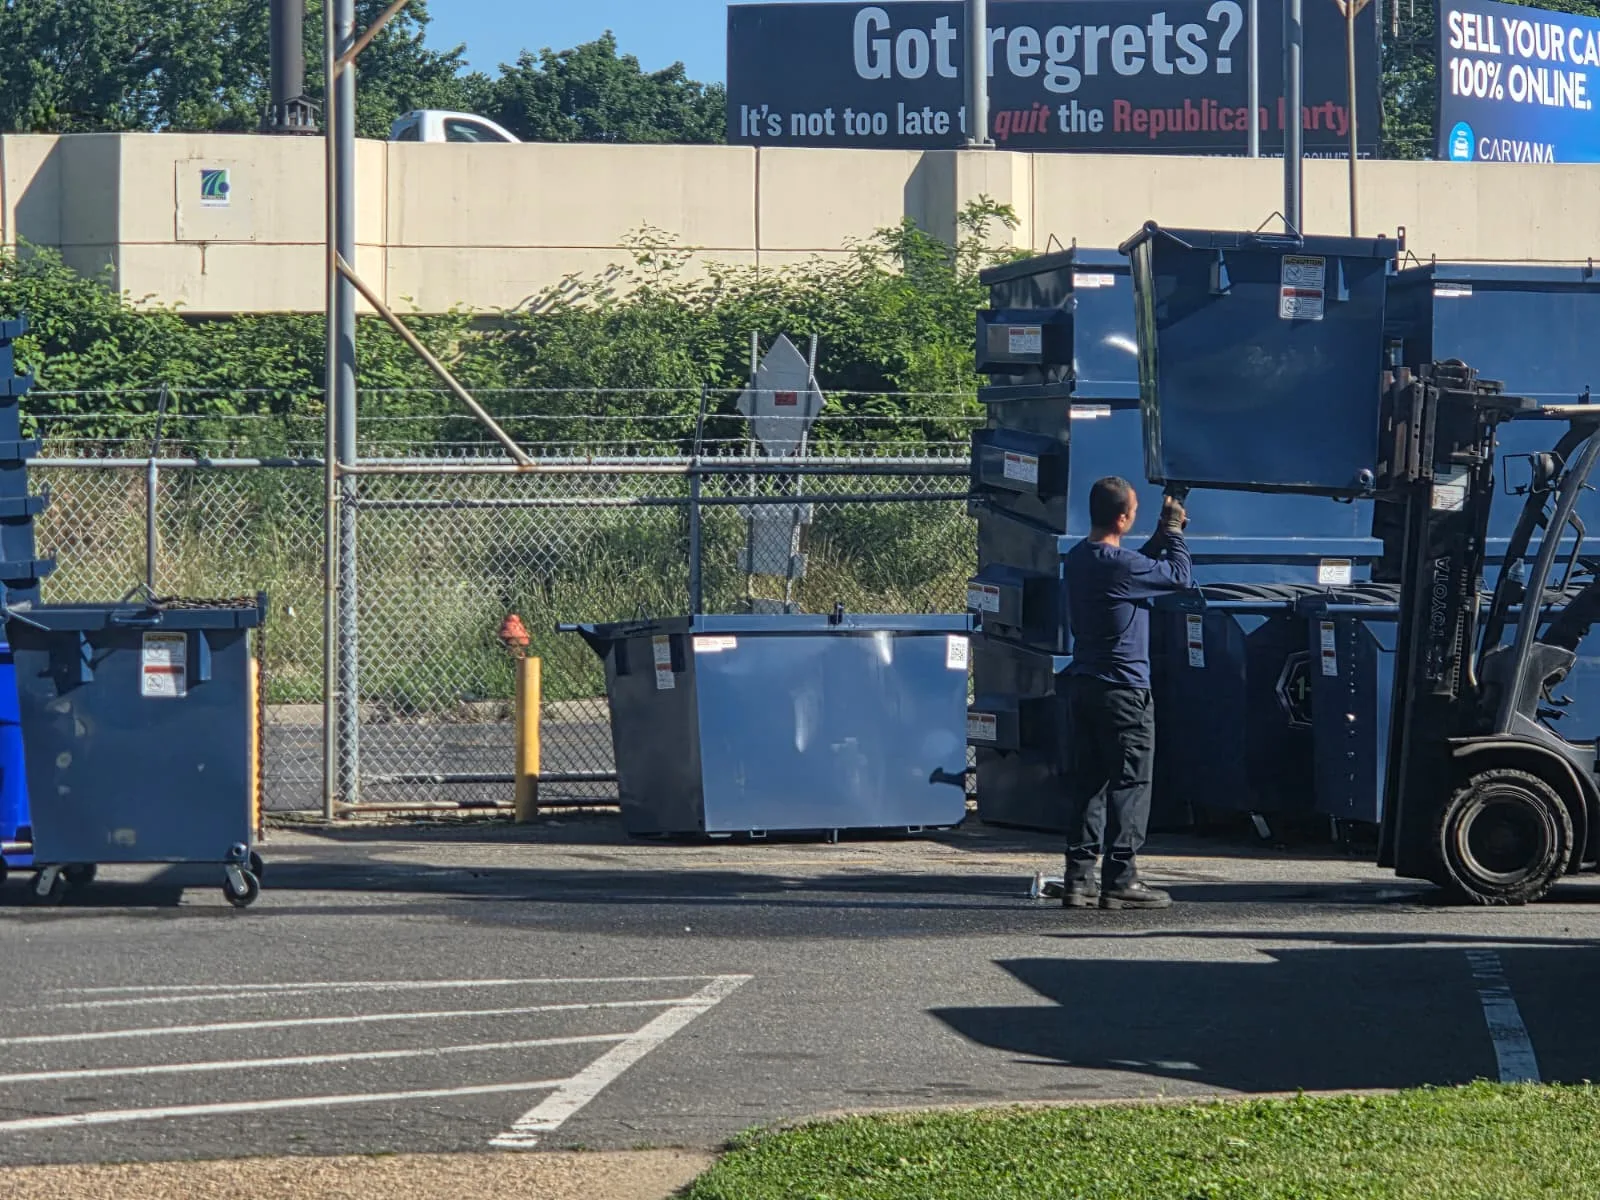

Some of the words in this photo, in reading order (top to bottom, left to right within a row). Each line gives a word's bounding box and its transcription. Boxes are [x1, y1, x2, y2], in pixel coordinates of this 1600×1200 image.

[853, 6, 957, 79] Got
[986, 0, 1243, 93] regrets?
[1449, 10, 1501, 54] SELL
[1502, 17, 1565, 62] YOUR
[1568, 27, 1600, 67] CA
[1449, 57, 1503, 100] 100%
[1508, 64, 1592, 110] ONLINE.
[740, 104, 782, 136] It’s
[791, 107, 835, 136] not
[843, 107, 888, 135] too
[897, 102, 950, 134] late
[994, 102, 1051, 140] quit
[1057, 100, 1104, 133] the
[1112, 98, 1268, 139] Republican
[1479, 137, 1555, 163] CARVANA
